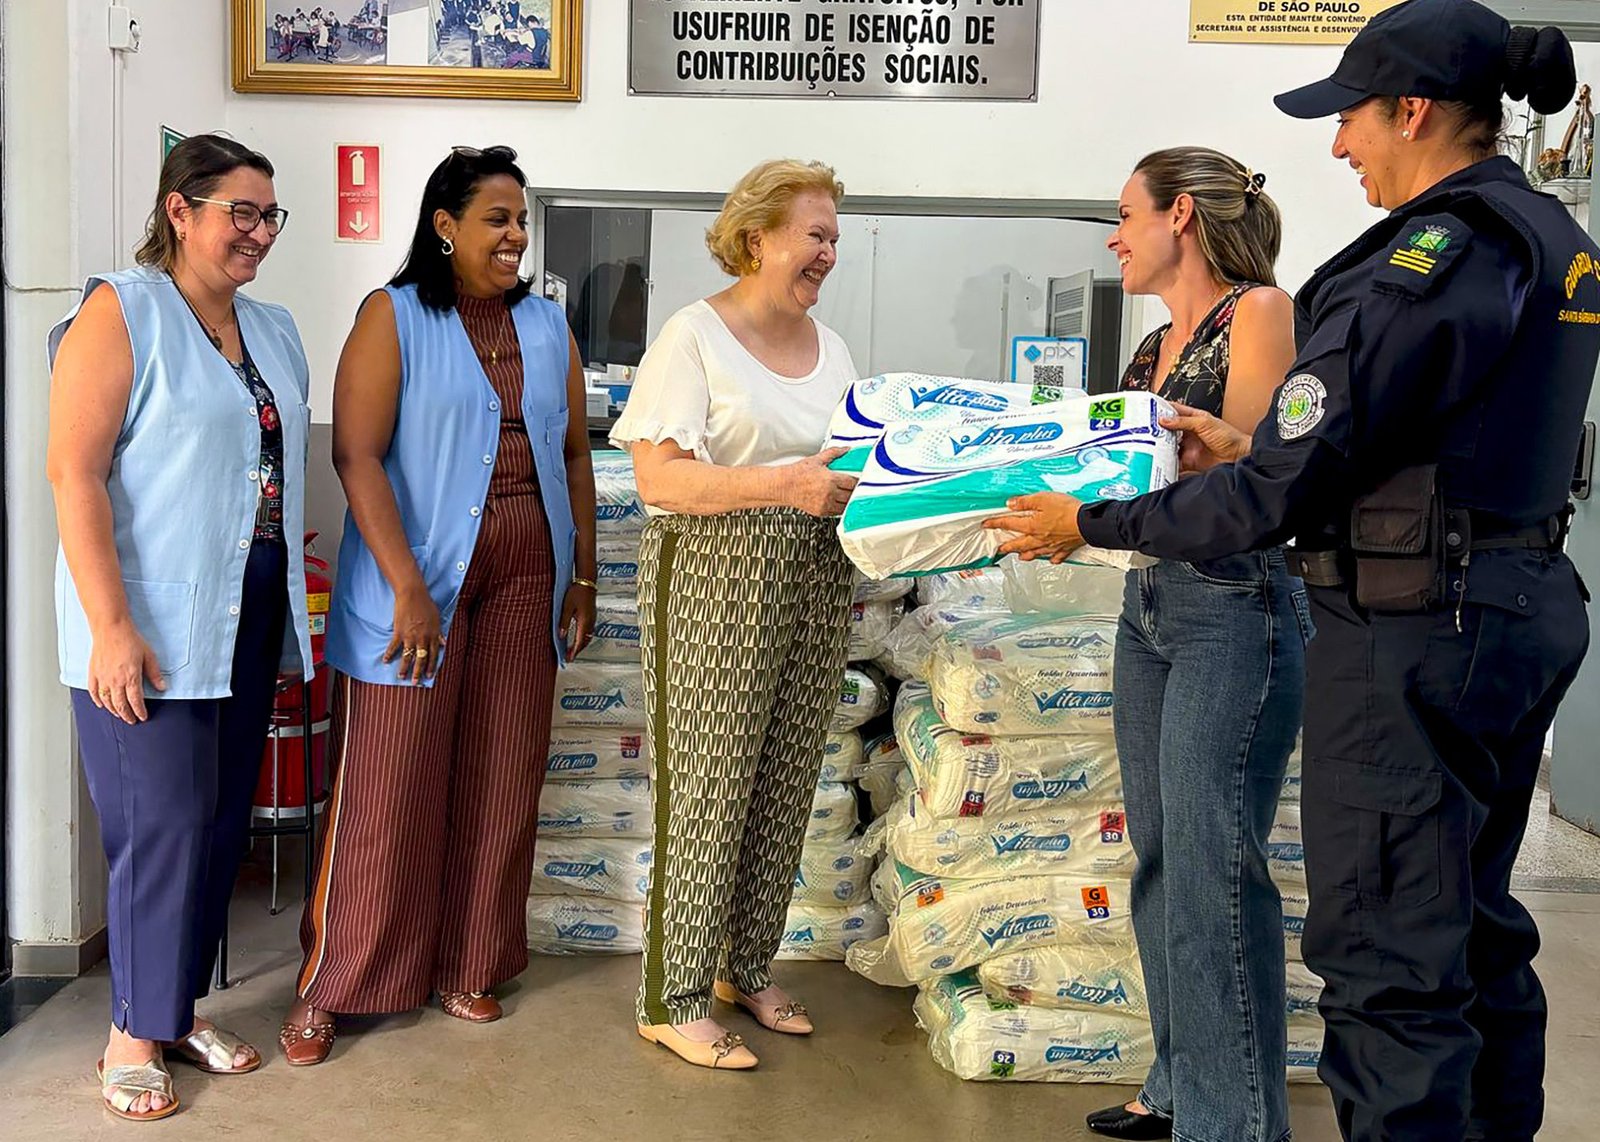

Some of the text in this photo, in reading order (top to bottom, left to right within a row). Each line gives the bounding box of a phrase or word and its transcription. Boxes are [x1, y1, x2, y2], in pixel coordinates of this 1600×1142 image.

[1258, 2, 1275, 12] DE
[1315, 2, 1360, 14] PAULO
[1289, 14, 1323, 22] MANTÉM
[1326, 14, 1366, 23] CONVÊNIO
[673, 9, 995, 50] USUFRUIR DE ISENÇÃO DE
[1195, 24, 1243, 32] SECRETARIA
[1260, 24, 1310, 33] ASSISTÊNCIA
[1321, 26, 1361, 34] DESENVOL
[677, 47, 988, 88] CONTRIBUIÇÕES SOCIAIS.
[1093, 399, 1121, 413] XG
[1014, 425, 1059, 446] plus
[968, 793, 982, 803] 30
[1104, 832, 1119, 841] 30
[1088, 887, 1101, 900] G
[1091, 906, 1105, 917] 30
[997, 1053, 1011, 1064] 26
